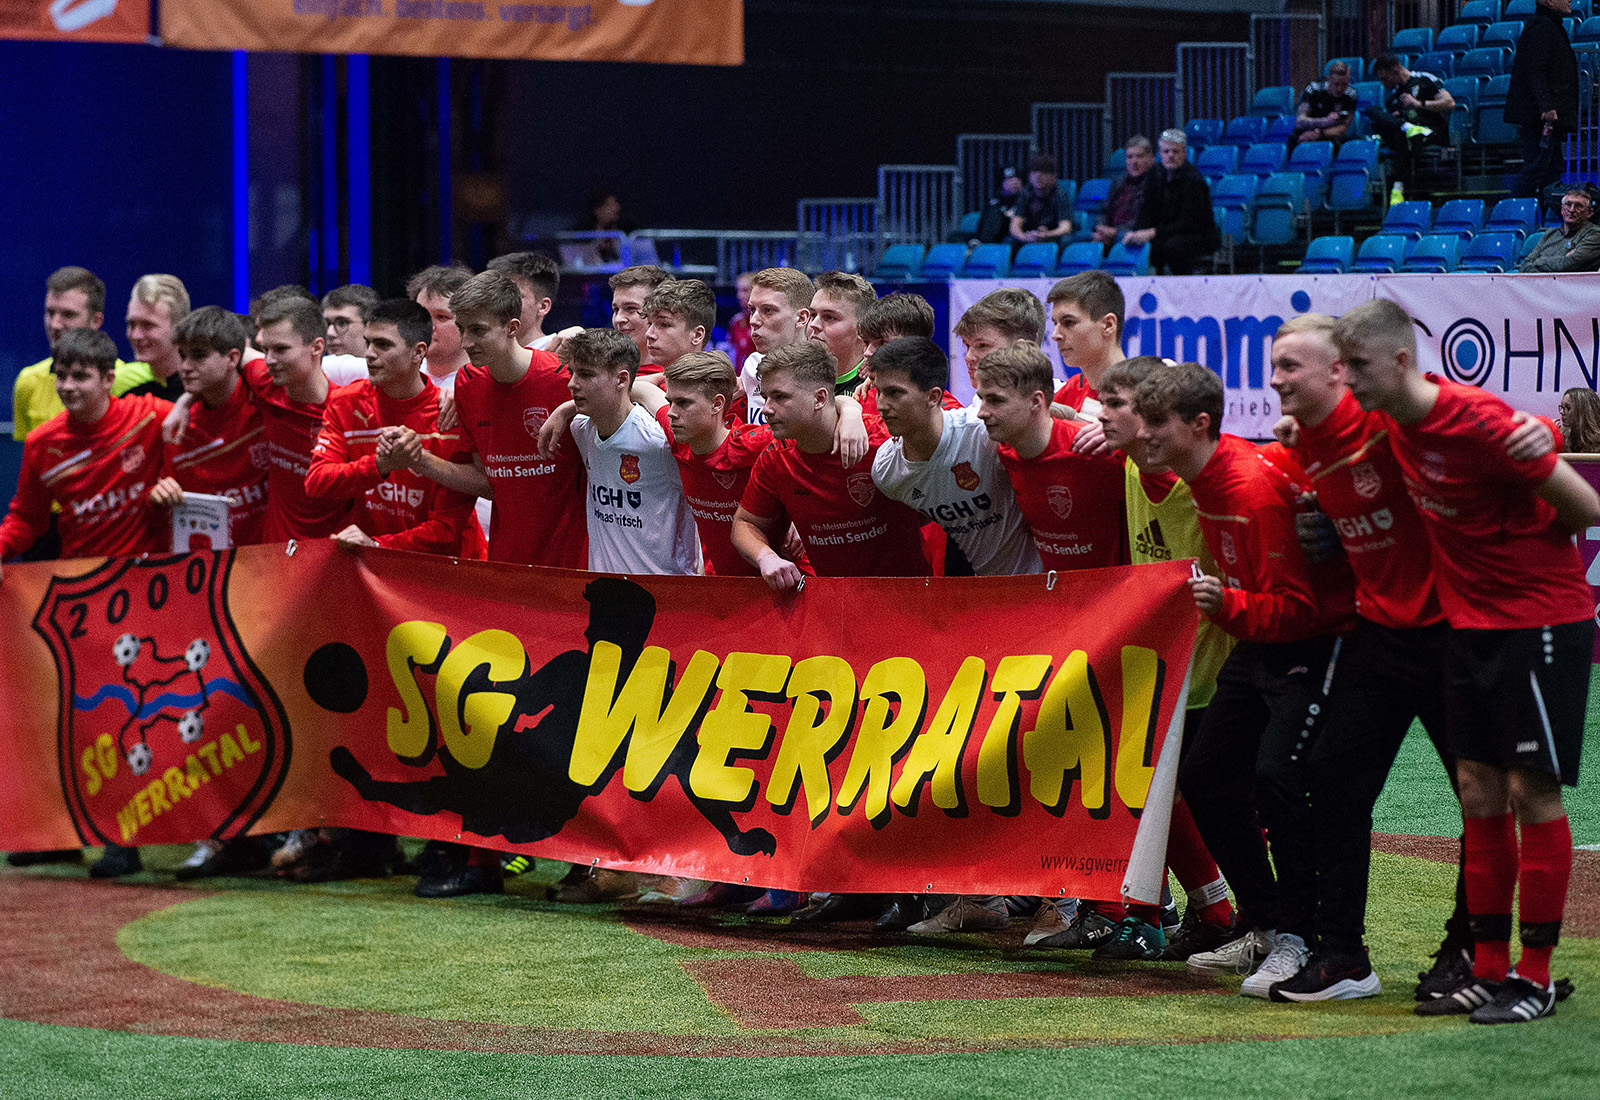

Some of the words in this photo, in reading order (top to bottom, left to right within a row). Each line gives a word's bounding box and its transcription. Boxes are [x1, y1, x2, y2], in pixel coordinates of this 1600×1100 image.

[1062, 289, 1311, 389] rimm
[1411, 316, 1599, 392] OHN
[1228, 395, 1272, 416] rieb
[514, 463, 556, 478] Sender
[365, 481, 407, 503] GH
[691, 508, 714, 521] artin
[713, 511, 734, 522] Sen
[810, 516, 877, 532] Kfz-Meisterbetrieb
[808, 534, 845, 546] Martin
[845, 523, 888, 543] Sender
[1052, 543, 1093, 555] Sender
[69, 557, 206, 640] 2000
[385, 620, 527, 769] SG
[569, 640, 1159, 822] WERRATAL
[81, 733, 118, 796] SG
[116, 723, 261, 842] WERRATAL
[1040, 855, 1131, 876] www.sgwerra
[1087, 926, 1113, 941] FILA
